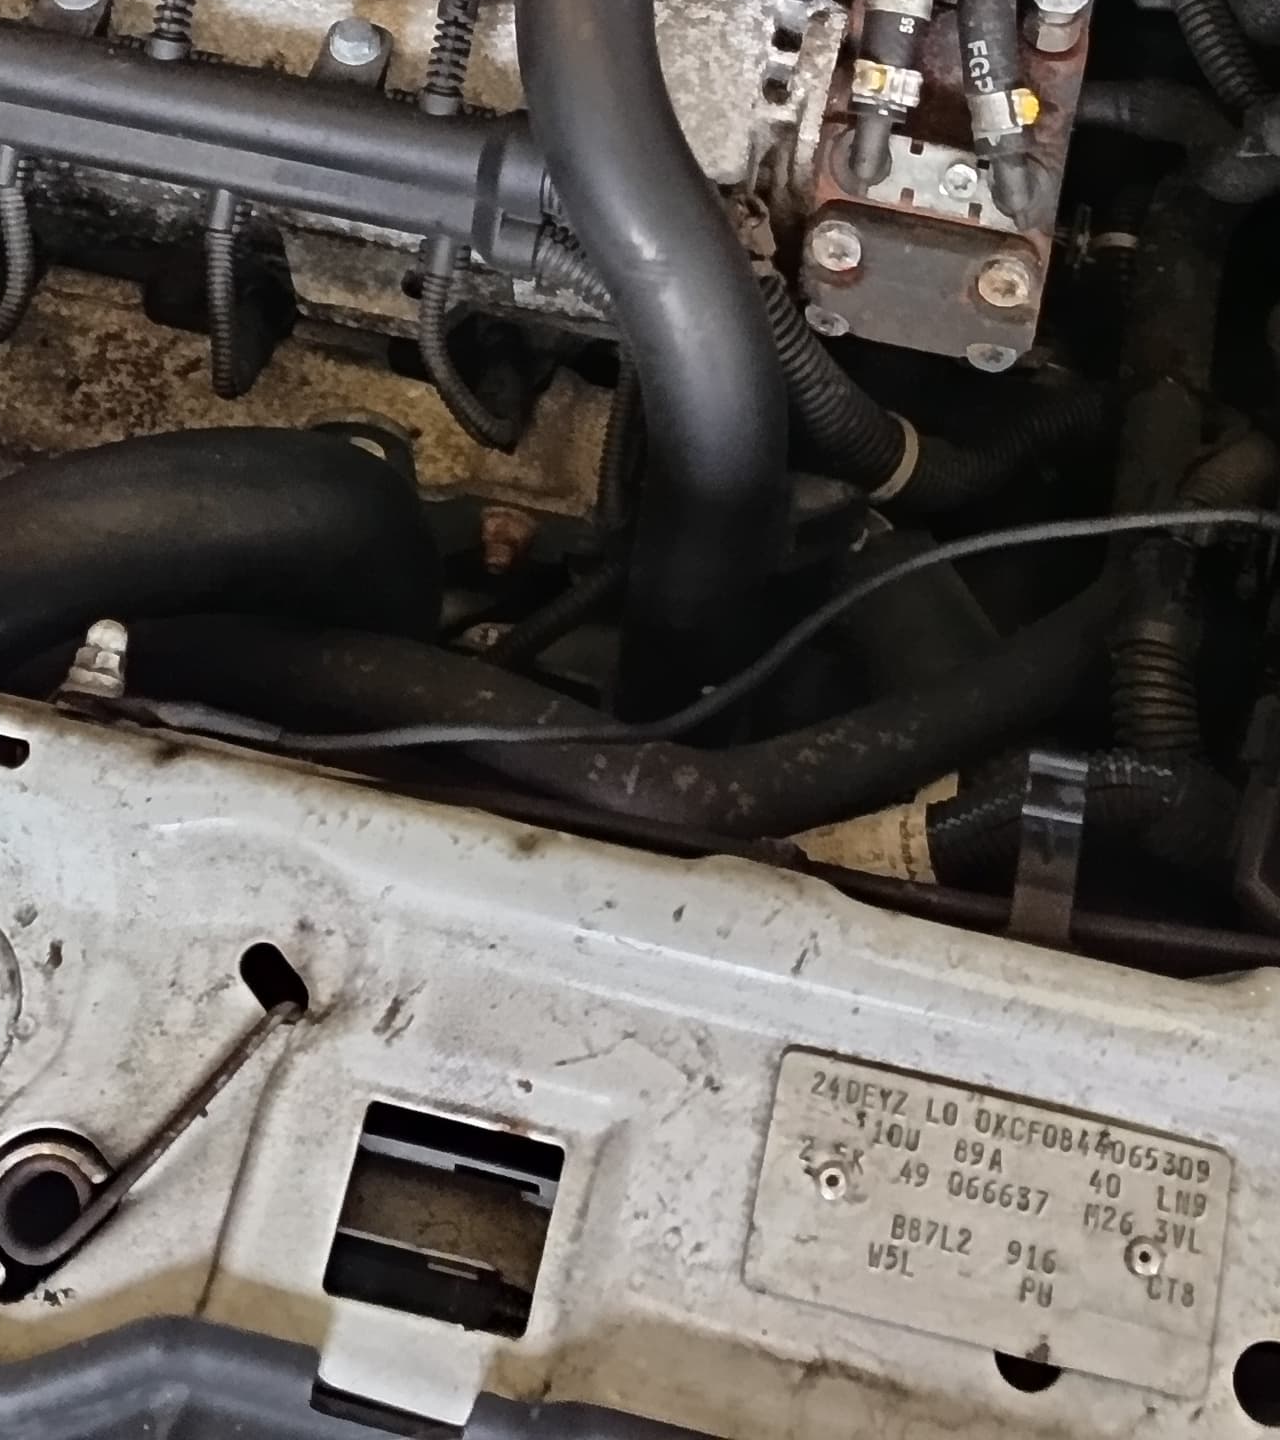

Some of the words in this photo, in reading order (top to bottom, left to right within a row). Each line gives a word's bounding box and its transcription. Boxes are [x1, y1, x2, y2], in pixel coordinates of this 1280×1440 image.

[899, 1159, 930, 1188] 49
[1083, 1202, 1134, 1237] M26
[1153, 1217, 1202, 1255] 3VL
[868, 1241, 915, 1278] W5L
[1006, 1239, 1057, 1275] 916
